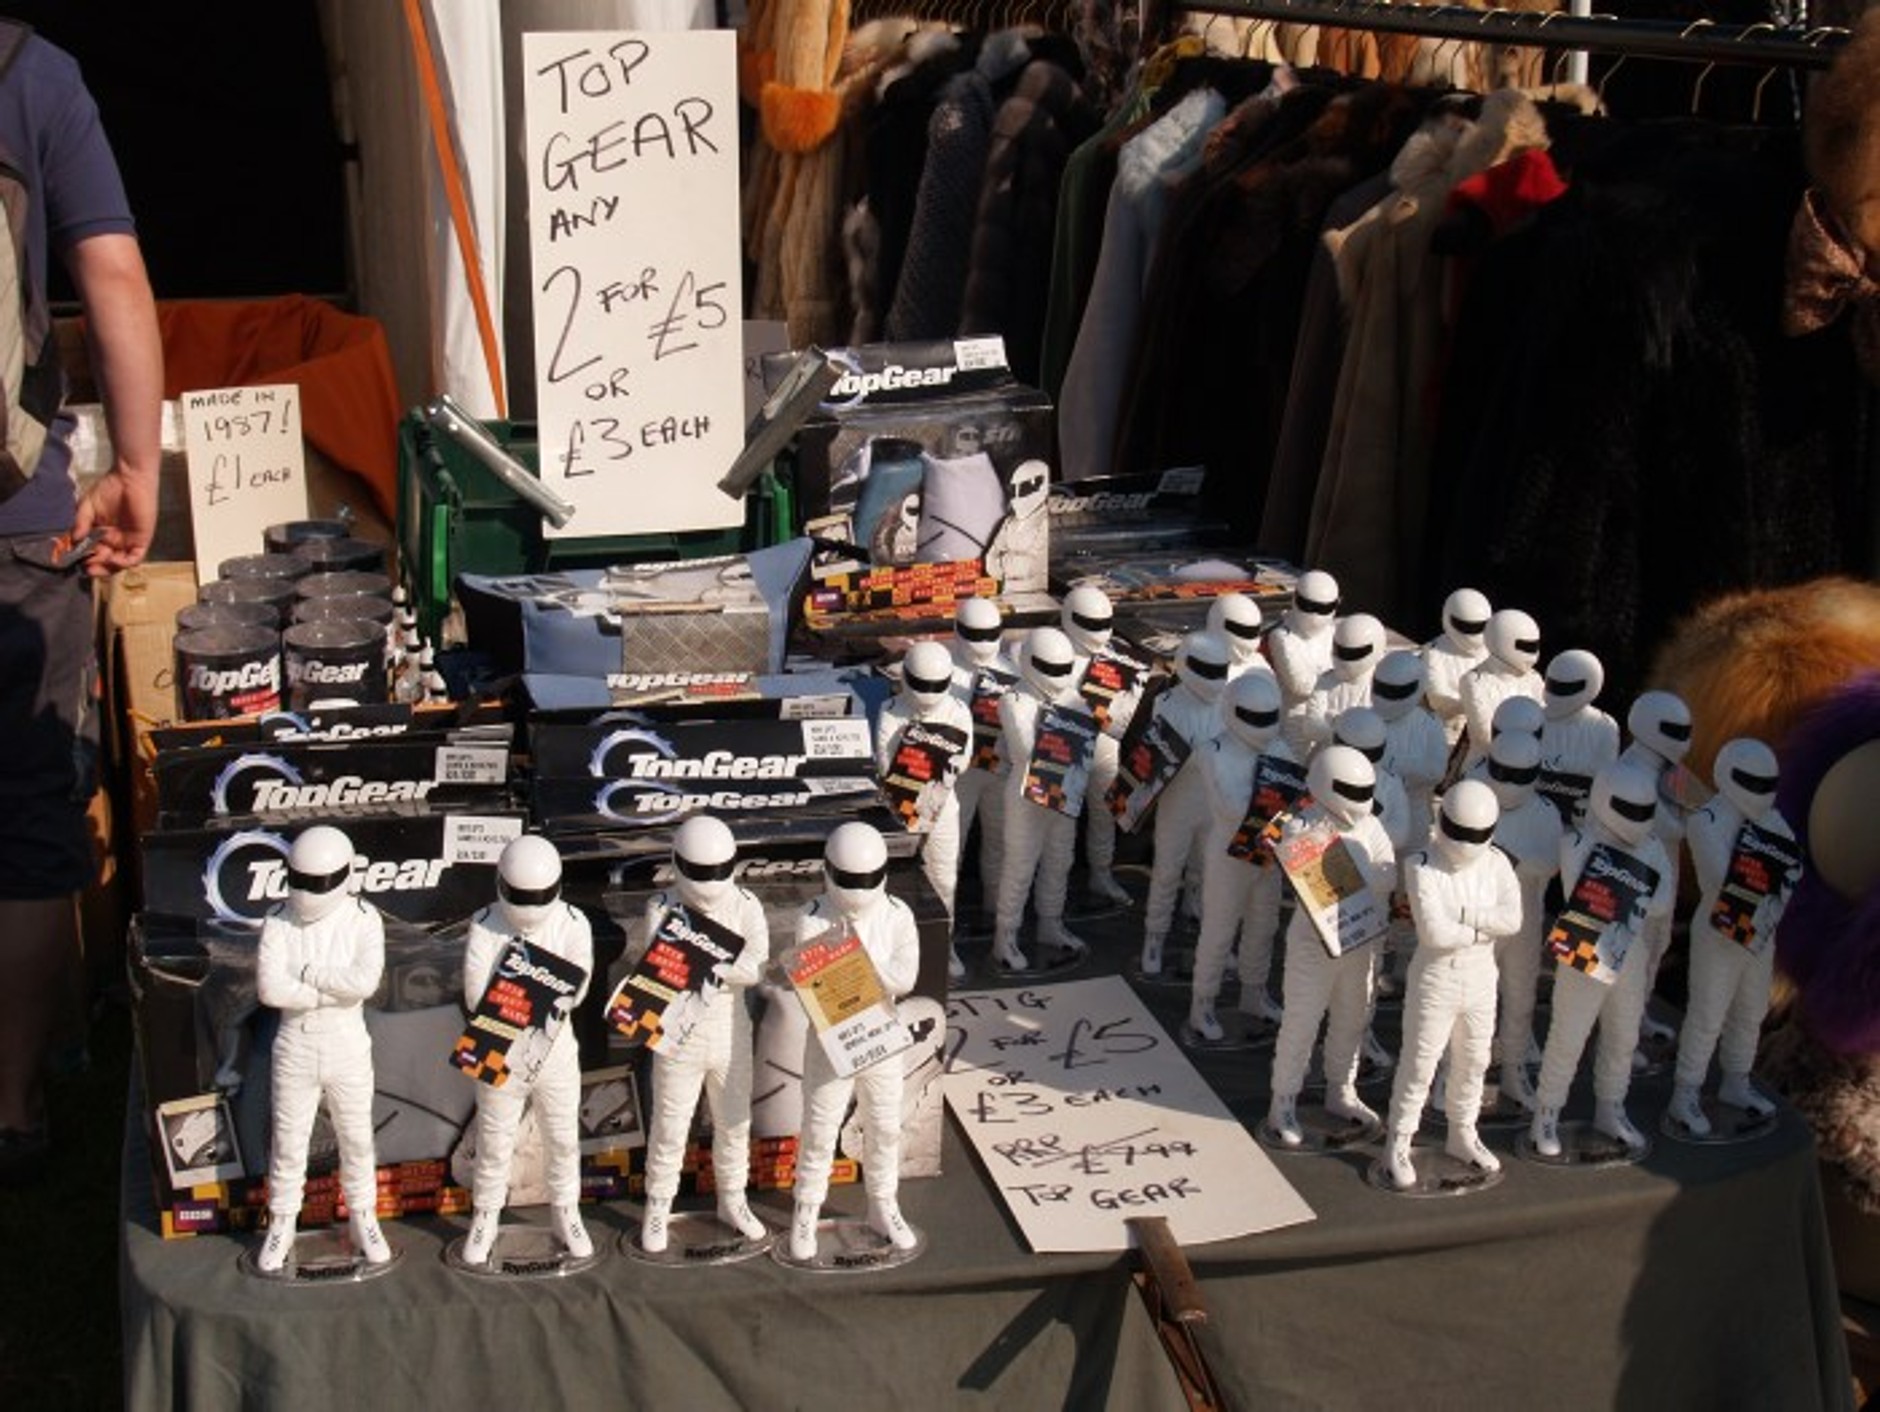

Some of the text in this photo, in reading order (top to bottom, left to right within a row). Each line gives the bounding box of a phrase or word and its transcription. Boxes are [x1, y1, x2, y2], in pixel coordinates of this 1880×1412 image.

[537, 40, 650, 114] TOP
[543, 97, 719, 192] GEAR
[550, 196, 620, 243] ANY
[542, 265, 727, 383] 2 FOR £5
[190, 390, 275, 410] MADE IN
[584, 367, 630, 401] OR
[558, 416, 711, 479] £3 EACH
[204, 453, 242, 506] £1
[188, 658, 276, 696] TopGe
[634, 792, 812, 814] TopGear
[247, 853, 452, 901] Toear
[946, 991, 1053, 1018] TIG
[1049, 1018, 1159, 1069] £5
[968, 1084, 1162, 1123] £3 EACH
[1006, 1177, 1202, 1209] TOP GEAR
